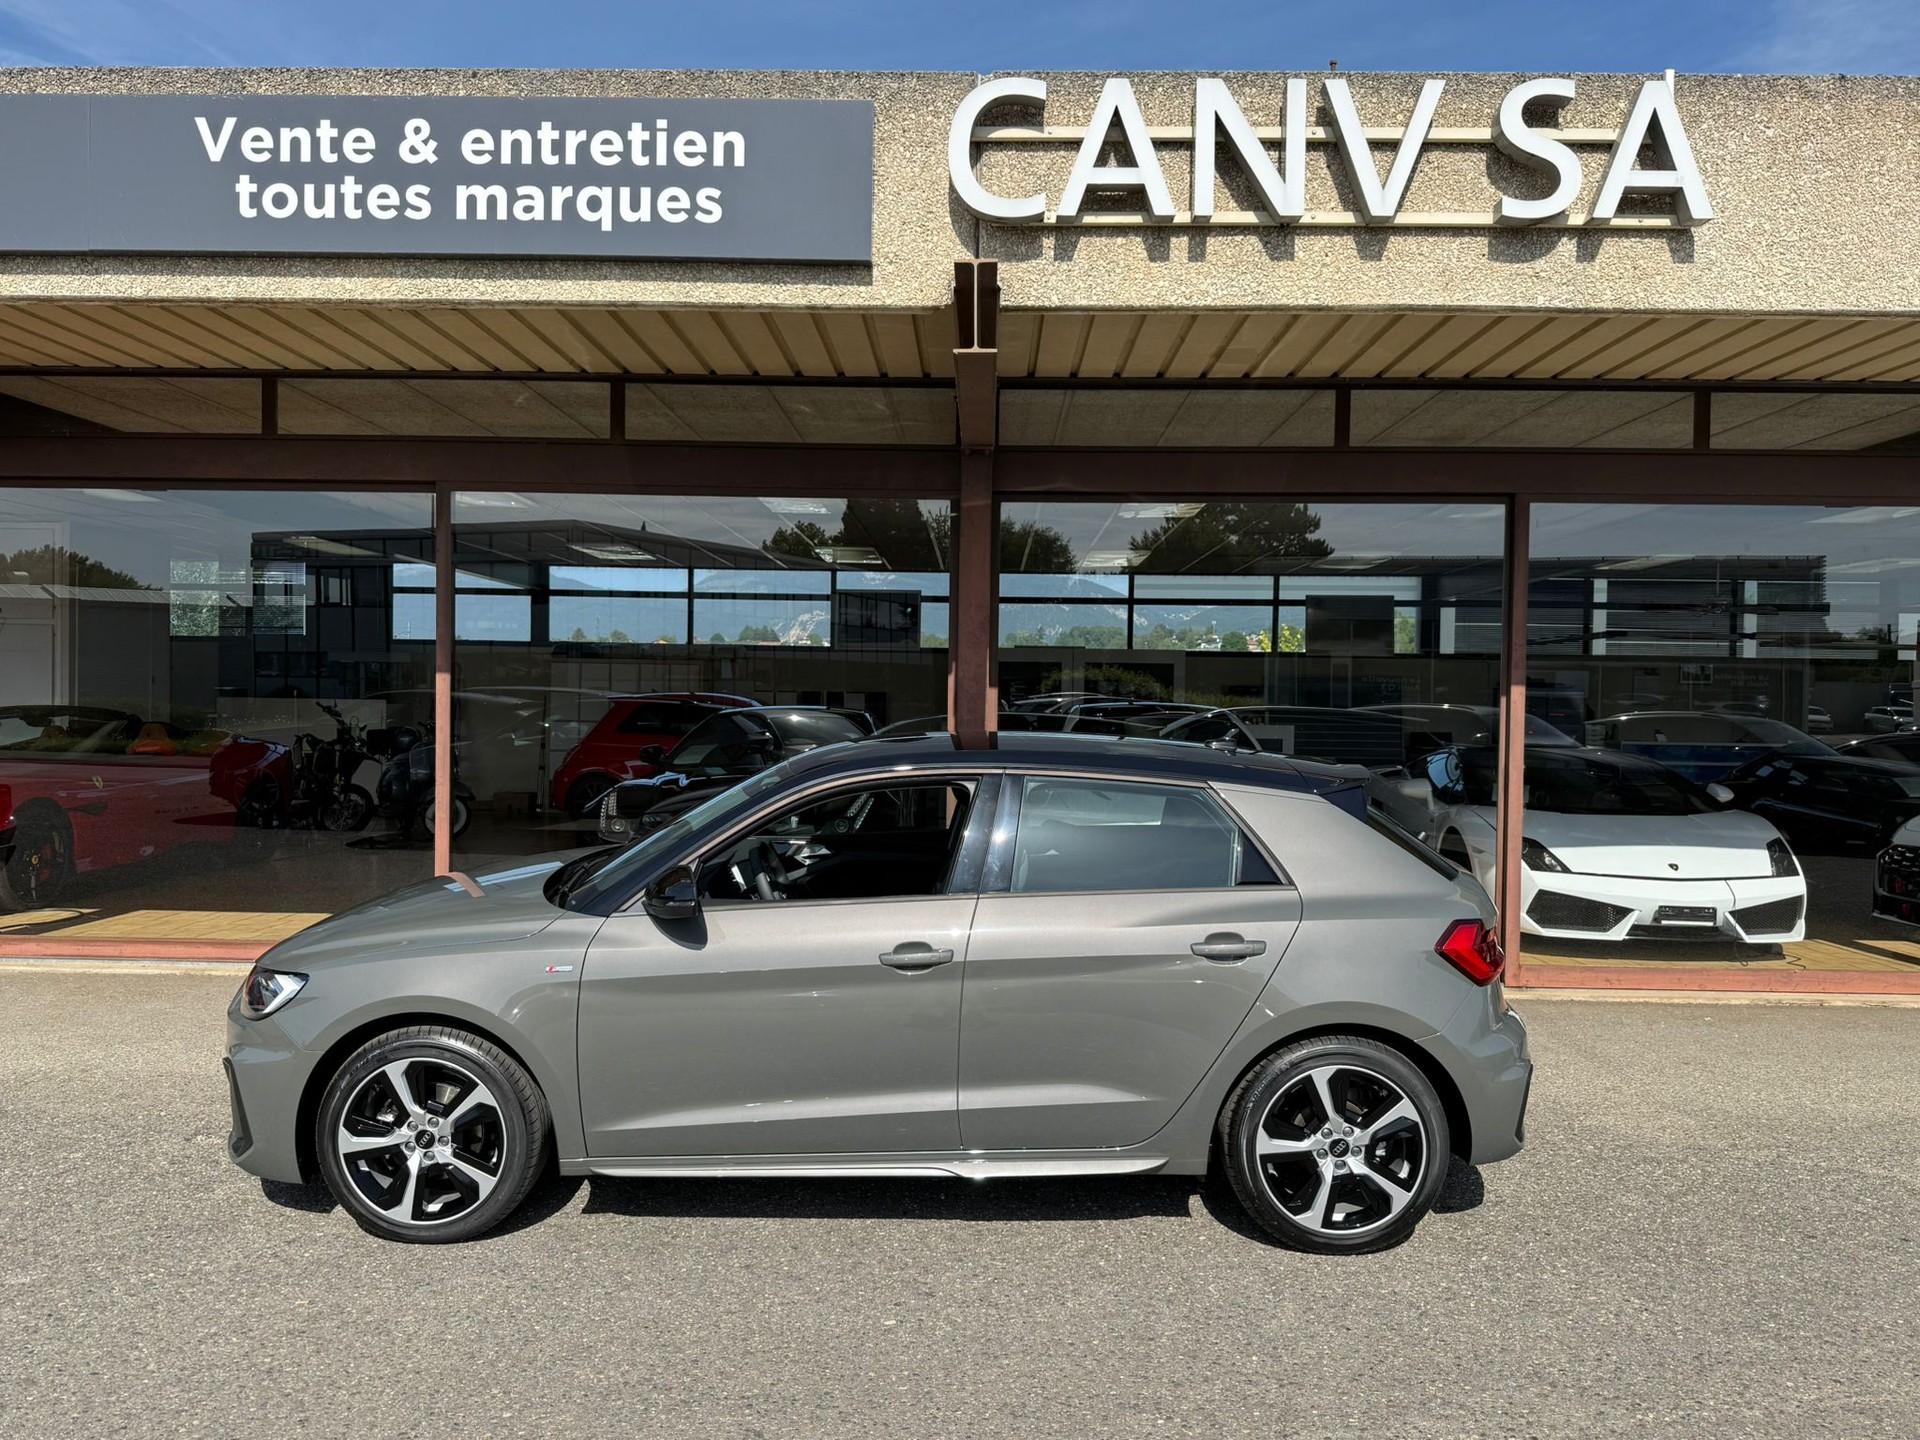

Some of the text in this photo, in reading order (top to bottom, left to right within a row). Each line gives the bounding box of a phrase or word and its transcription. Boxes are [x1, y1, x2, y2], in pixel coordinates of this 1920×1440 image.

[192, 117, 746, 168] Vente & entretien
[948, 76, 1716, 222] CANV SA
[234, 174, 724, 232] toutes marques
